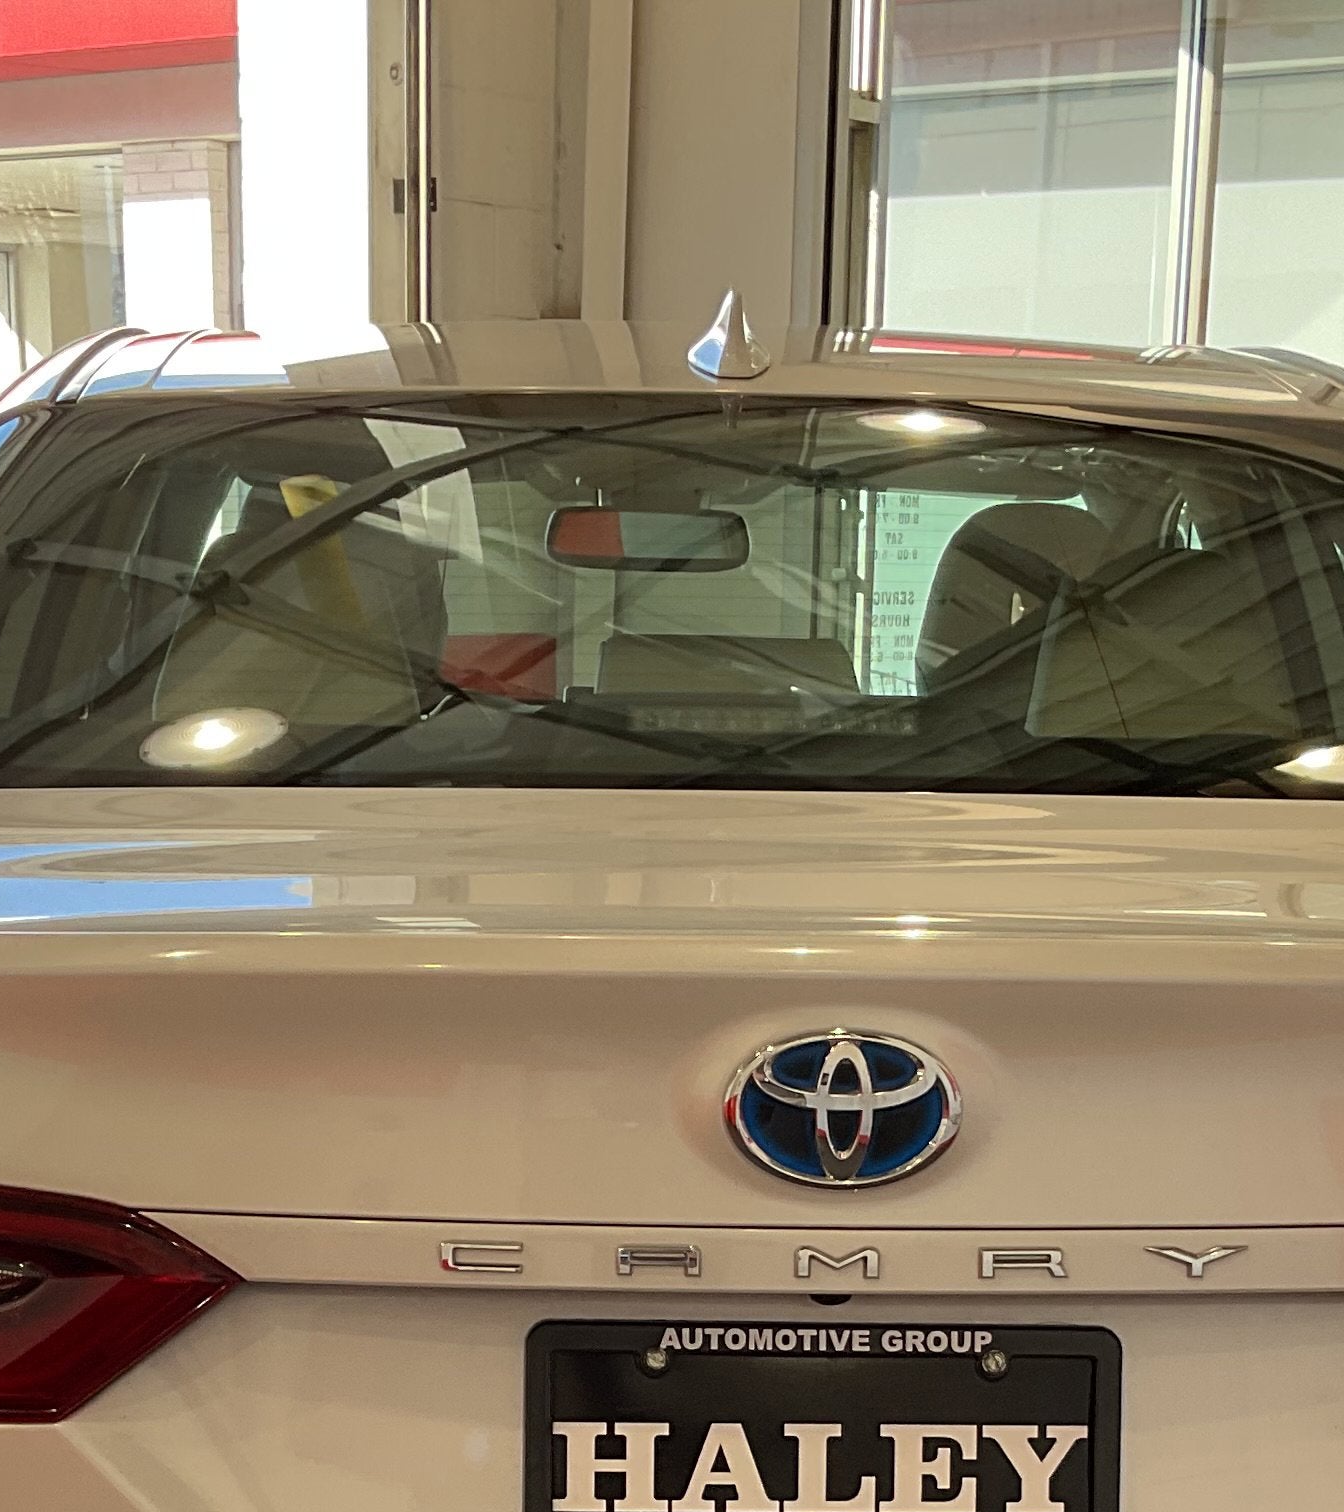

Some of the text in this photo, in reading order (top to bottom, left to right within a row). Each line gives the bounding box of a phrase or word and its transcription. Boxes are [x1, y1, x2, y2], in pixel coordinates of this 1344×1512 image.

[439, 1239, 1249, 1279] CAMRY
[659, 1327, 993, 1353] AUTOMOTIVE GROUP
